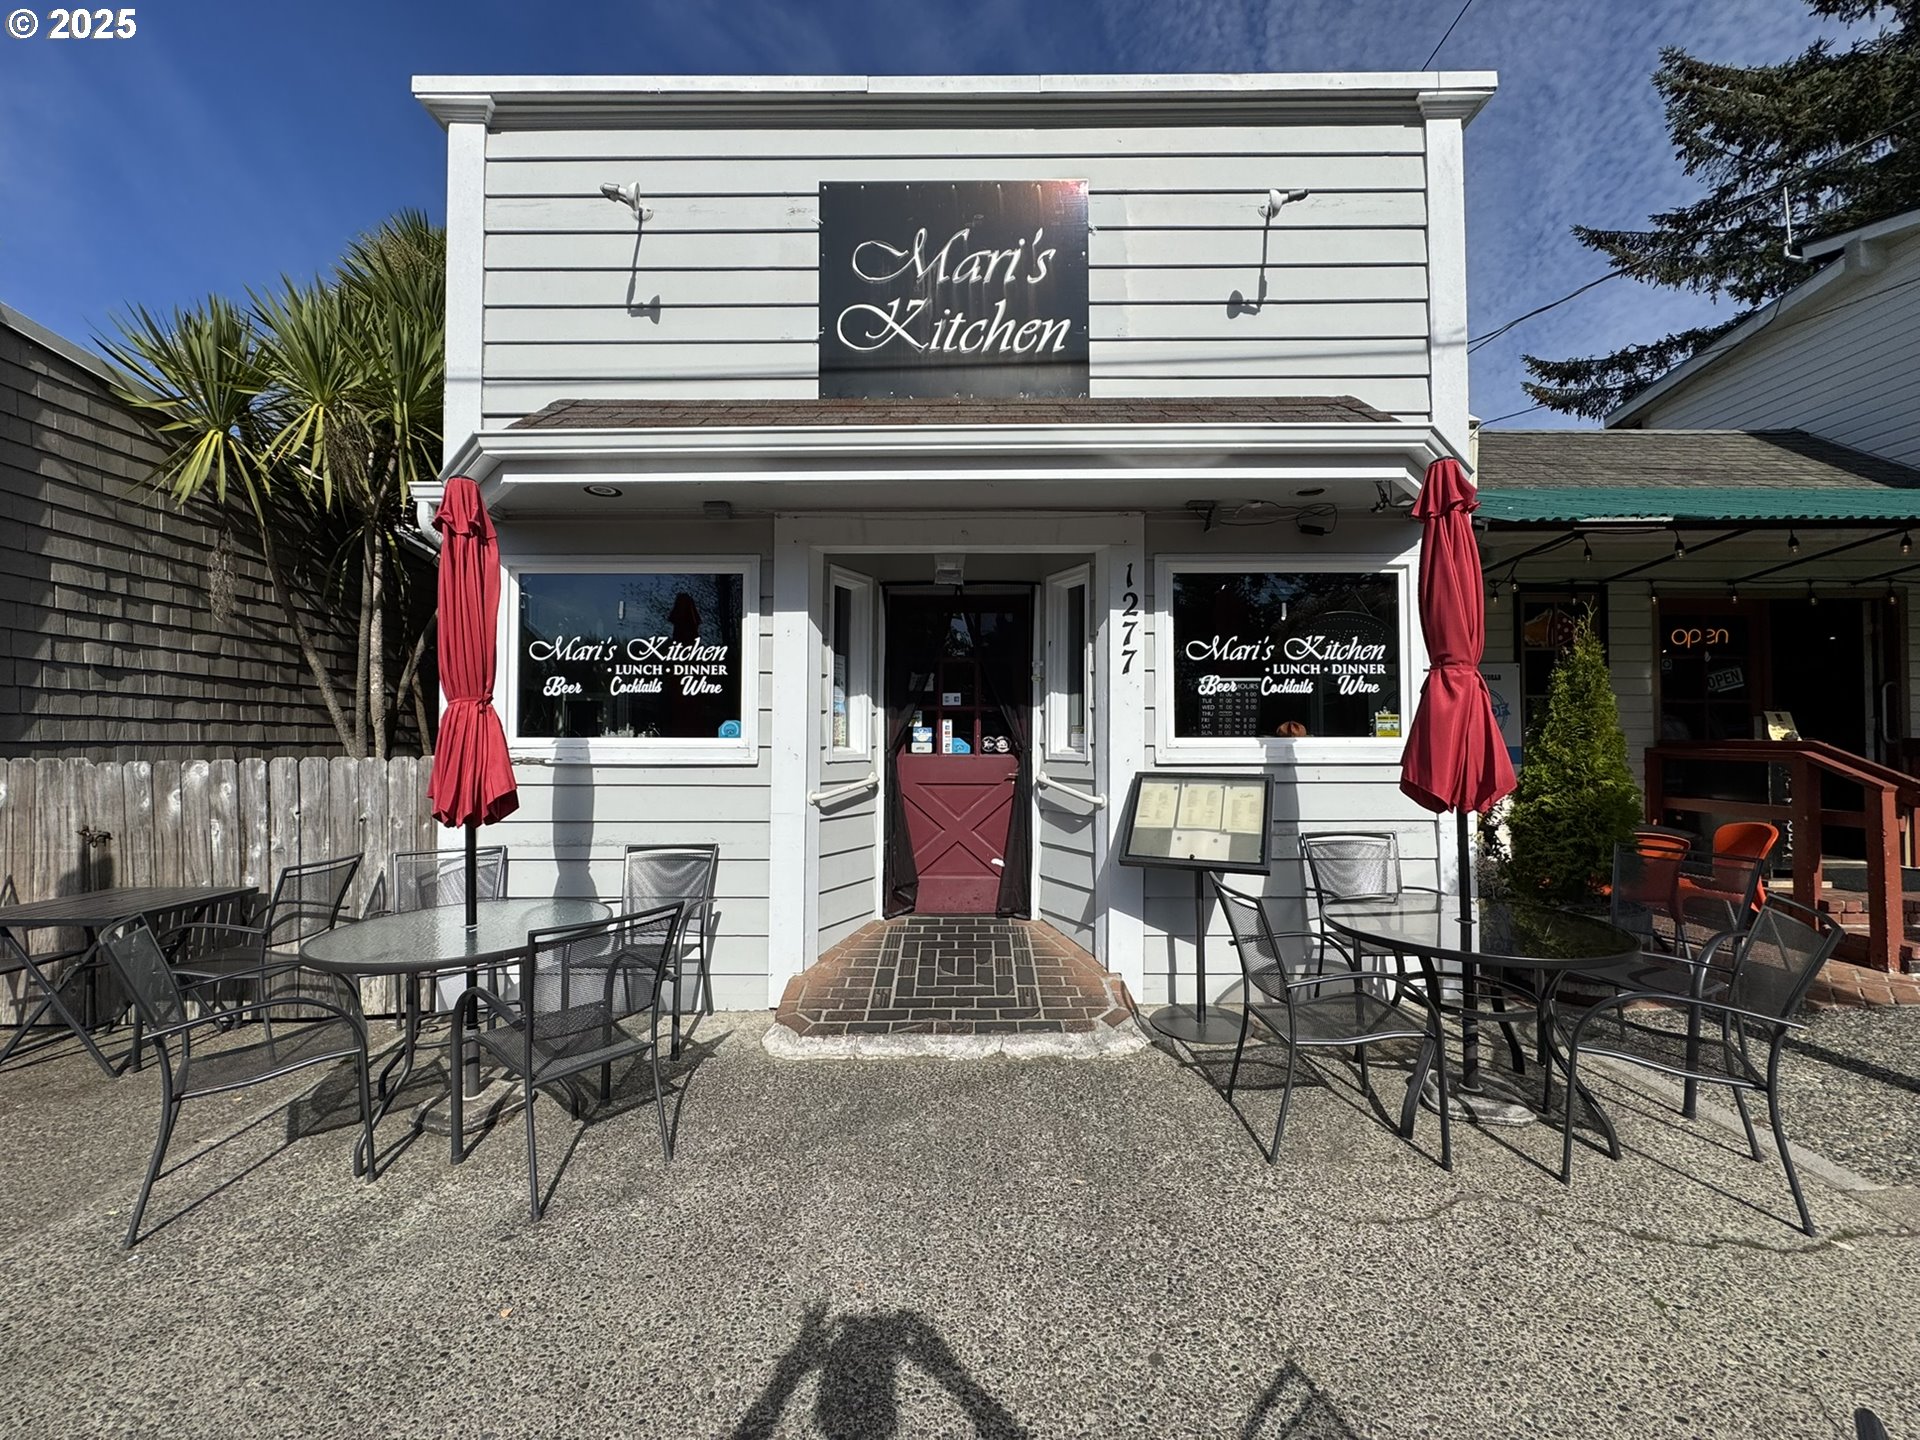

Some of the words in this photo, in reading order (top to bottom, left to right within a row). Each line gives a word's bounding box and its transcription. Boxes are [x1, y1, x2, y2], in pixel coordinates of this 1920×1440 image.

[852, 227, 1057, 283] Mari's
[836, 298, 1073, 353] Kitchen
[1121, 562, 1139, 675] 1277
[528, 635, 618, 661] Mari's
[626, 636, 729, 661] Kitchen
[1185, 635, 1275, 661] Mari's
[1284, 635, 1387, 661] Kitchen
[615, 664, 663, 676] LUNCH
[673, 664, 728, 676] DINNER
[1273, 664, 1321, 675] LUNCH
[1331, 664, 1387, 675] DINNER
[1707, 669, 1741, 689] OPEN
[543, 676, 583, 697] Beer
[610, 676, 663, 696] Cocktails
[680, 675, 723, 696] Wine
[1197, 675, 1238, 695] Beer
[1260, 676, 1314, 696] Cocktails
[1337, 675, 1380, 695] Wine
